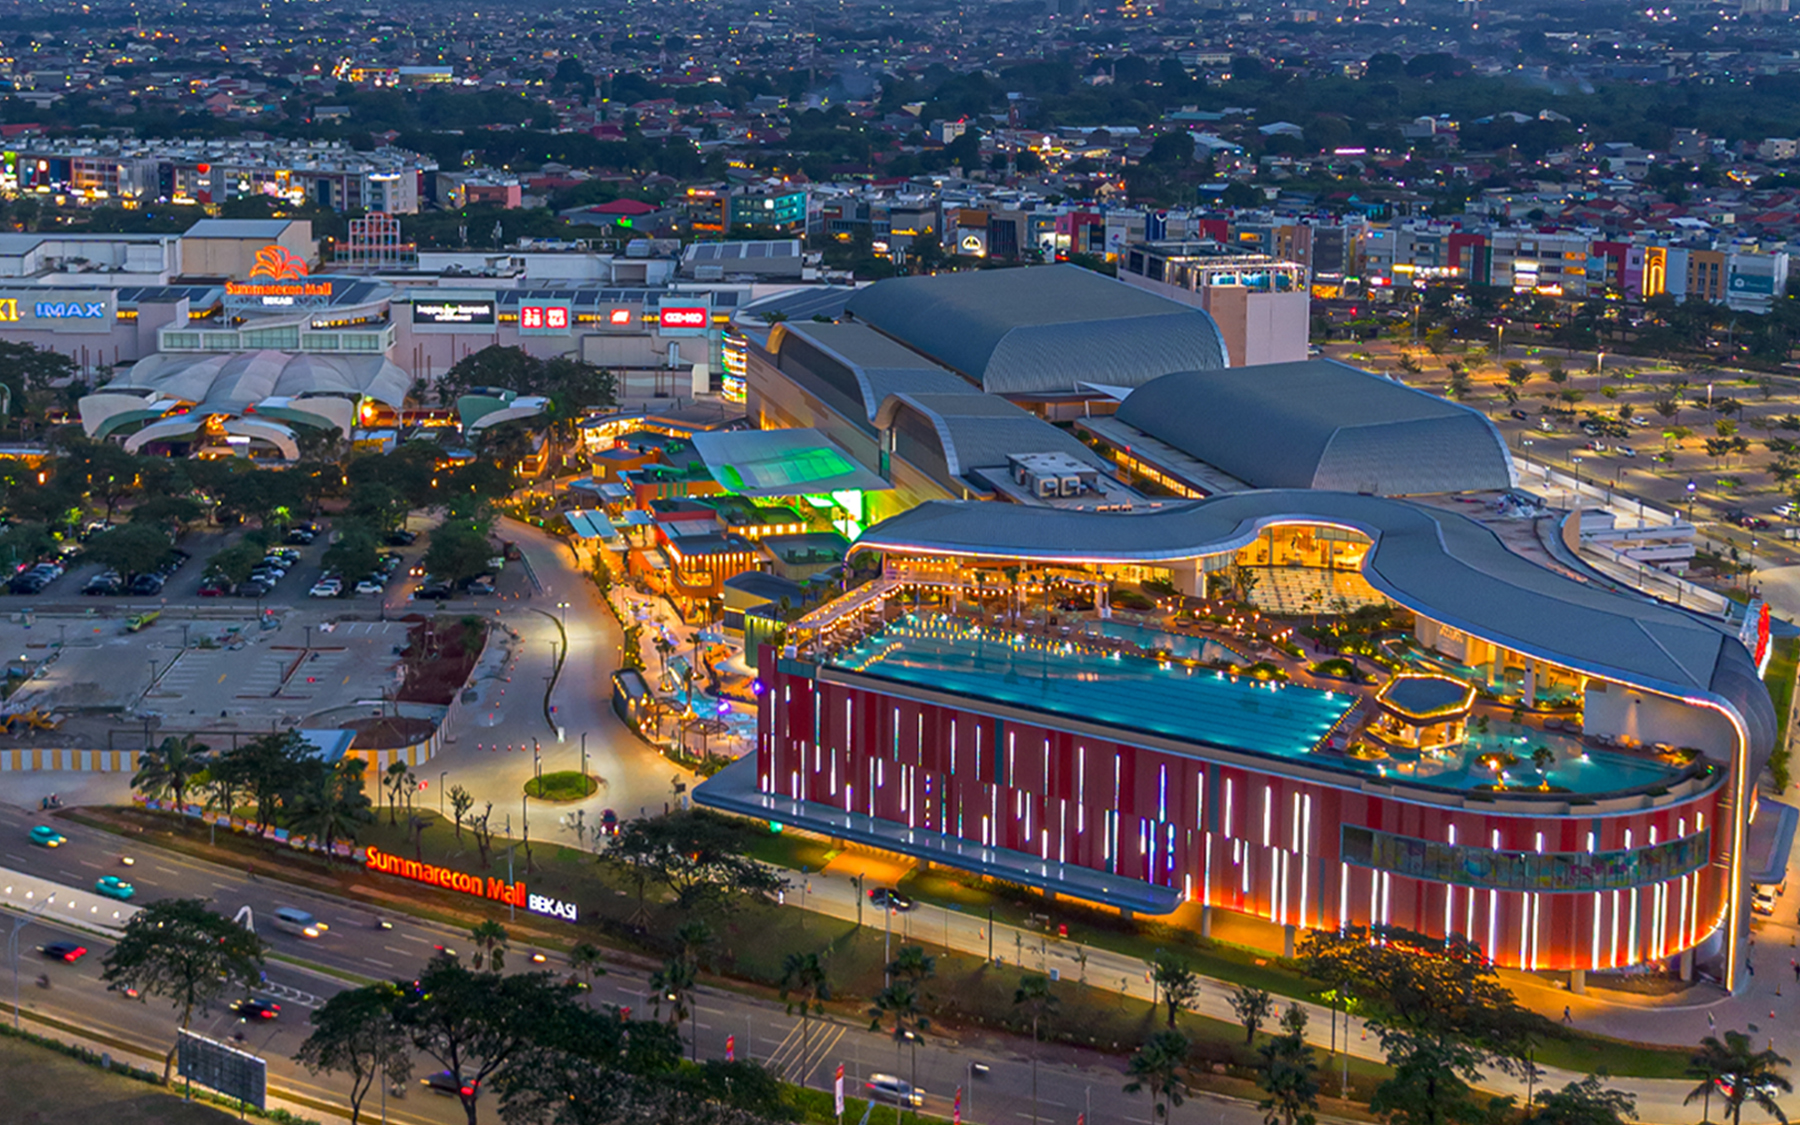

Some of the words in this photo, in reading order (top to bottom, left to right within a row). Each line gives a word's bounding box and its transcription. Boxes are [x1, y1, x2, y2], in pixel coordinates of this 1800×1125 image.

[225, 281, 304, 296] Summarecon
[304, 282, 332, 296] Mall
[35, 301, 104, 318] IMAX
[365, 845, 483, 896] Summarecon
[486, 876, 527, 908] Mall
[528, 893, 579, 921] BEKASI
